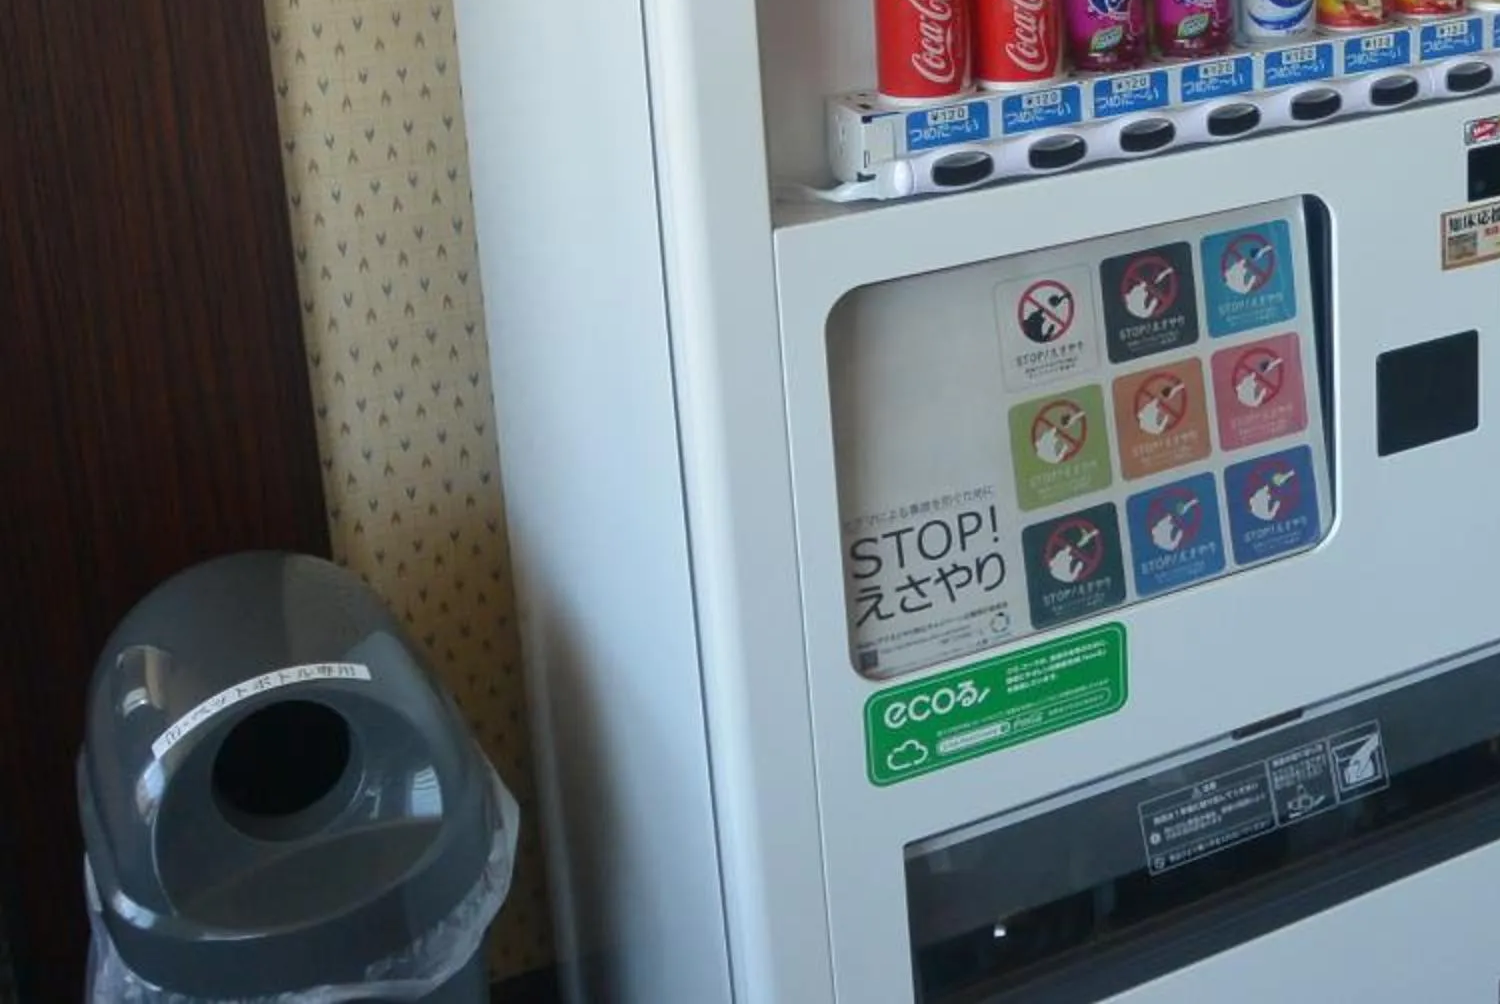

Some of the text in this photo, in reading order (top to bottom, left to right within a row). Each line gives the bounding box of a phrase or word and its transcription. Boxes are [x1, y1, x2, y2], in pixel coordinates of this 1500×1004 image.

[851, 504, 999, 580] STOP!
[855, 552, 1006, 629] えさやり
